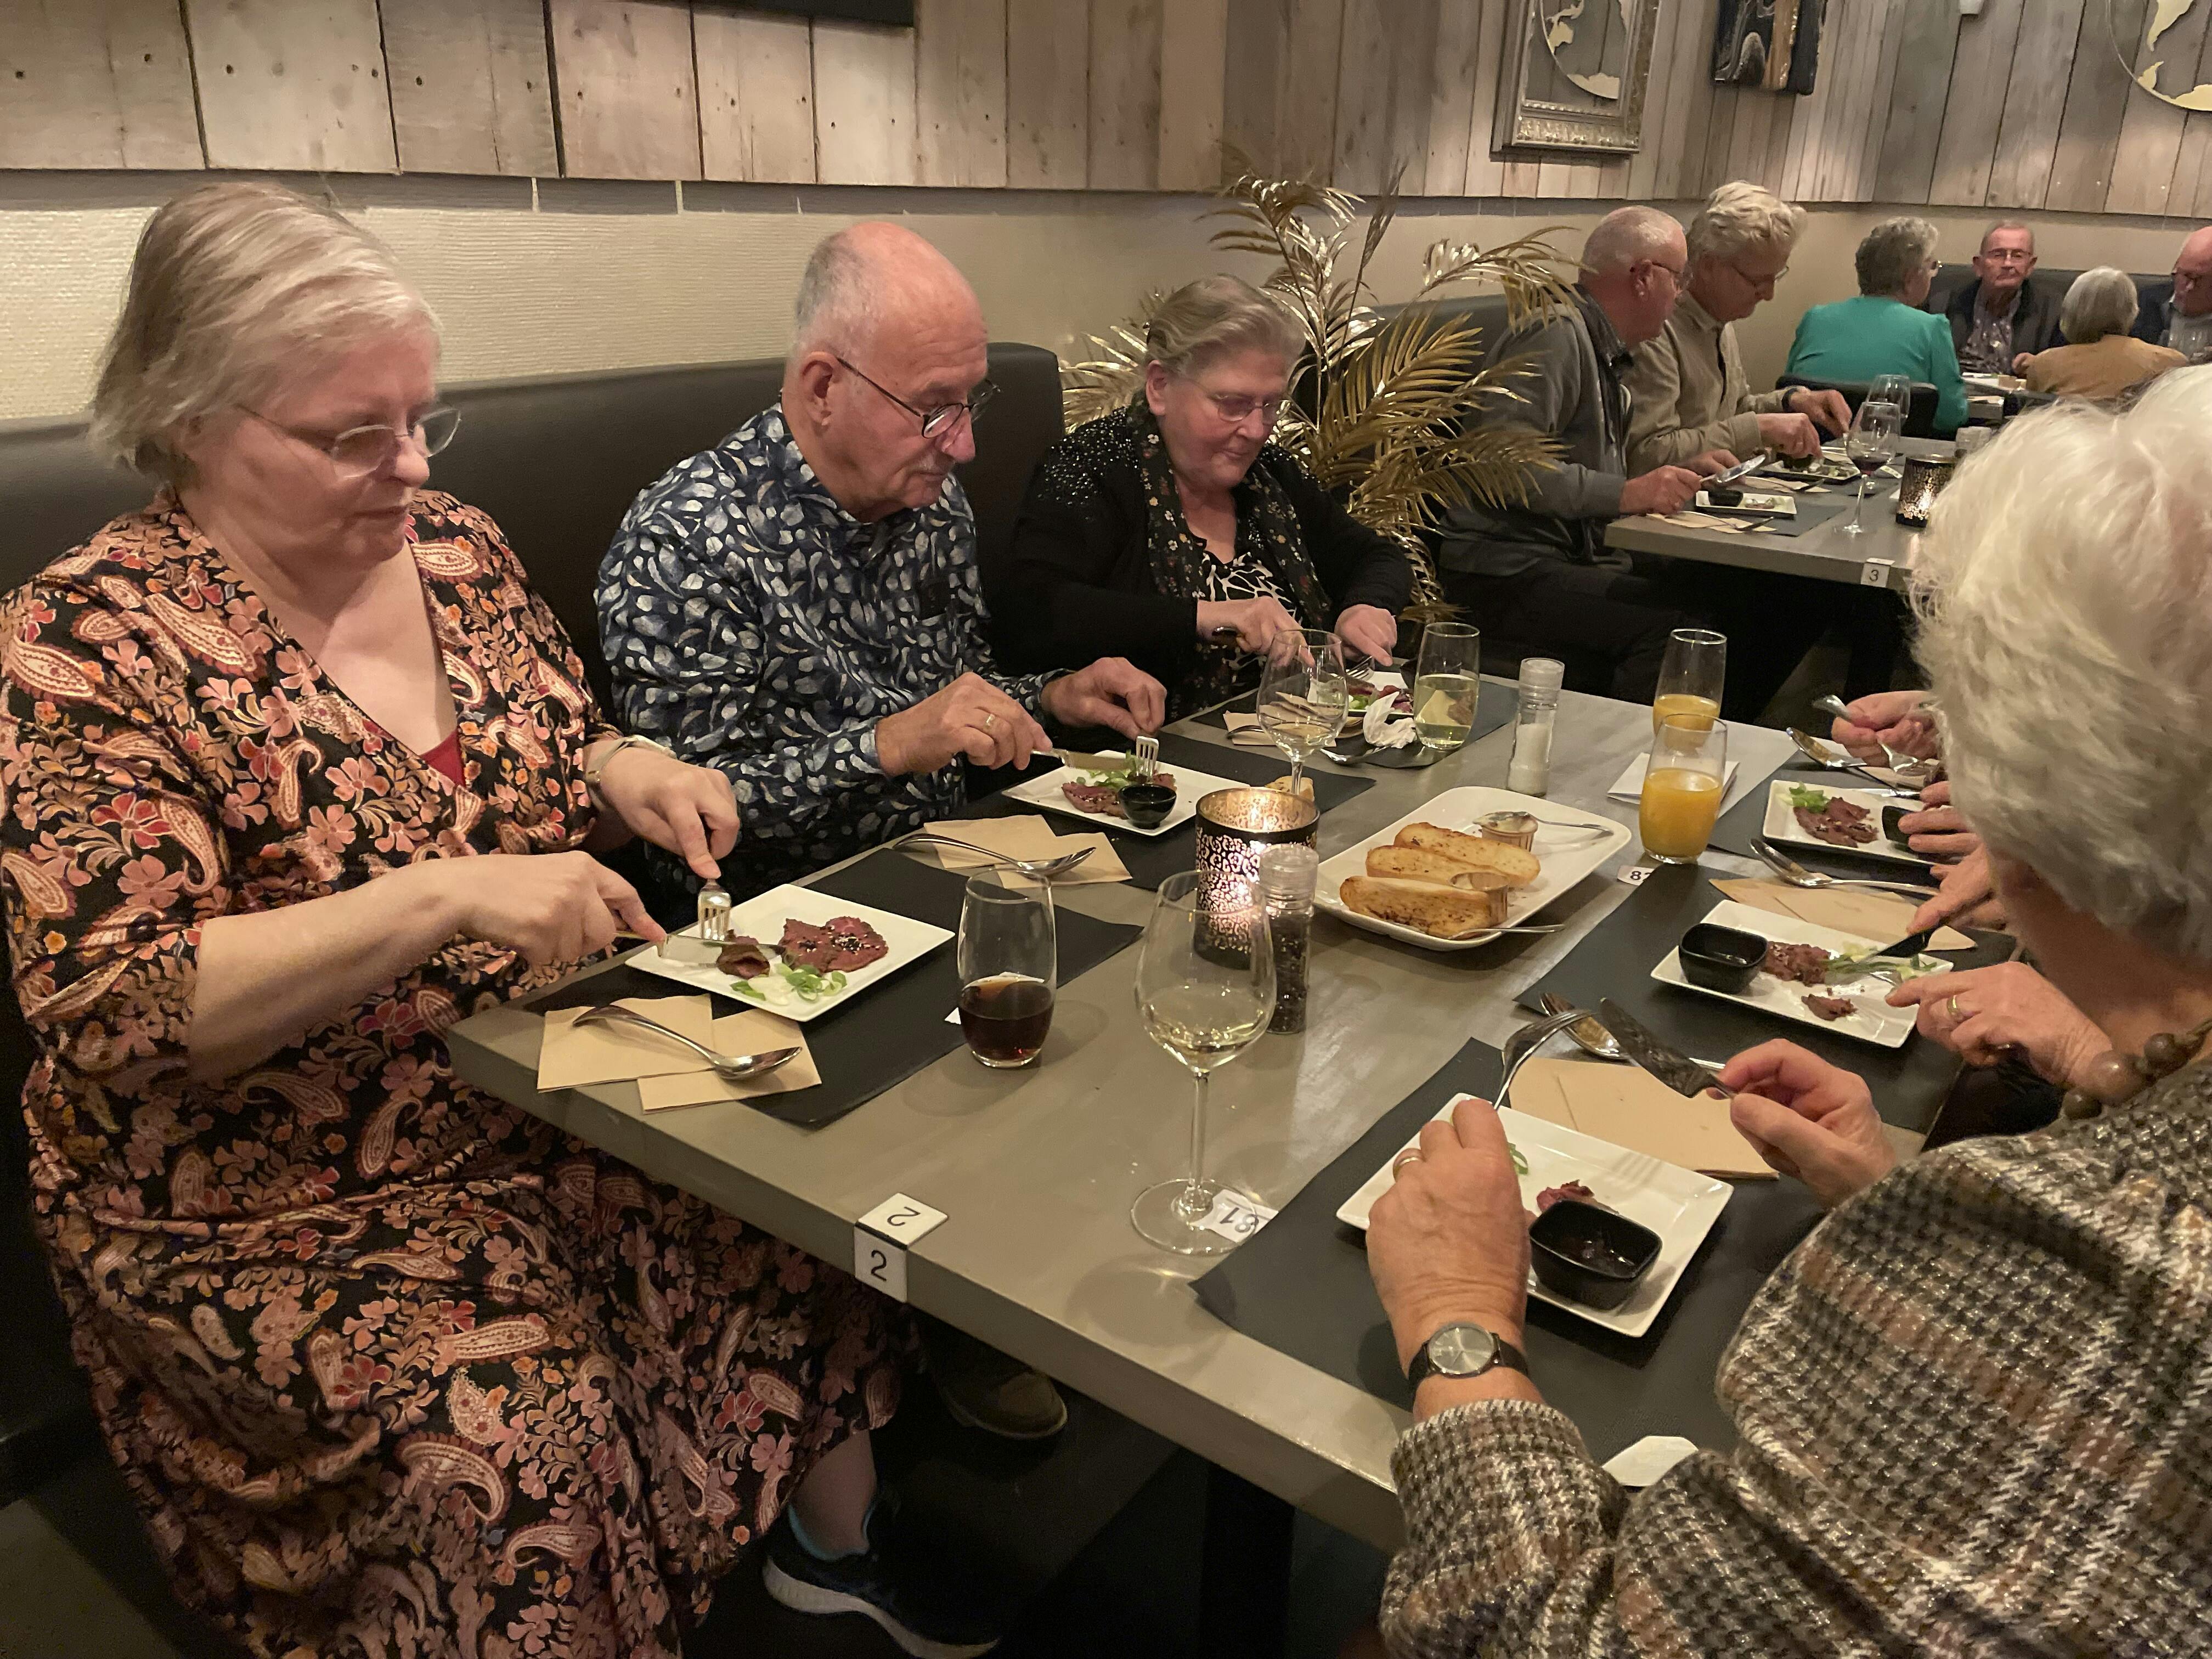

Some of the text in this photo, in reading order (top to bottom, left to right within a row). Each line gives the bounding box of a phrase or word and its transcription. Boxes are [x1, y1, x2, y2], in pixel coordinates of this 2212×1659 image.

[1869, 569, 1879, 582] 3
[1630, 871, 1652, 880] 8
[887, 1206, 921, 1226] 2
[871, 1250, 887, 1282] 2
